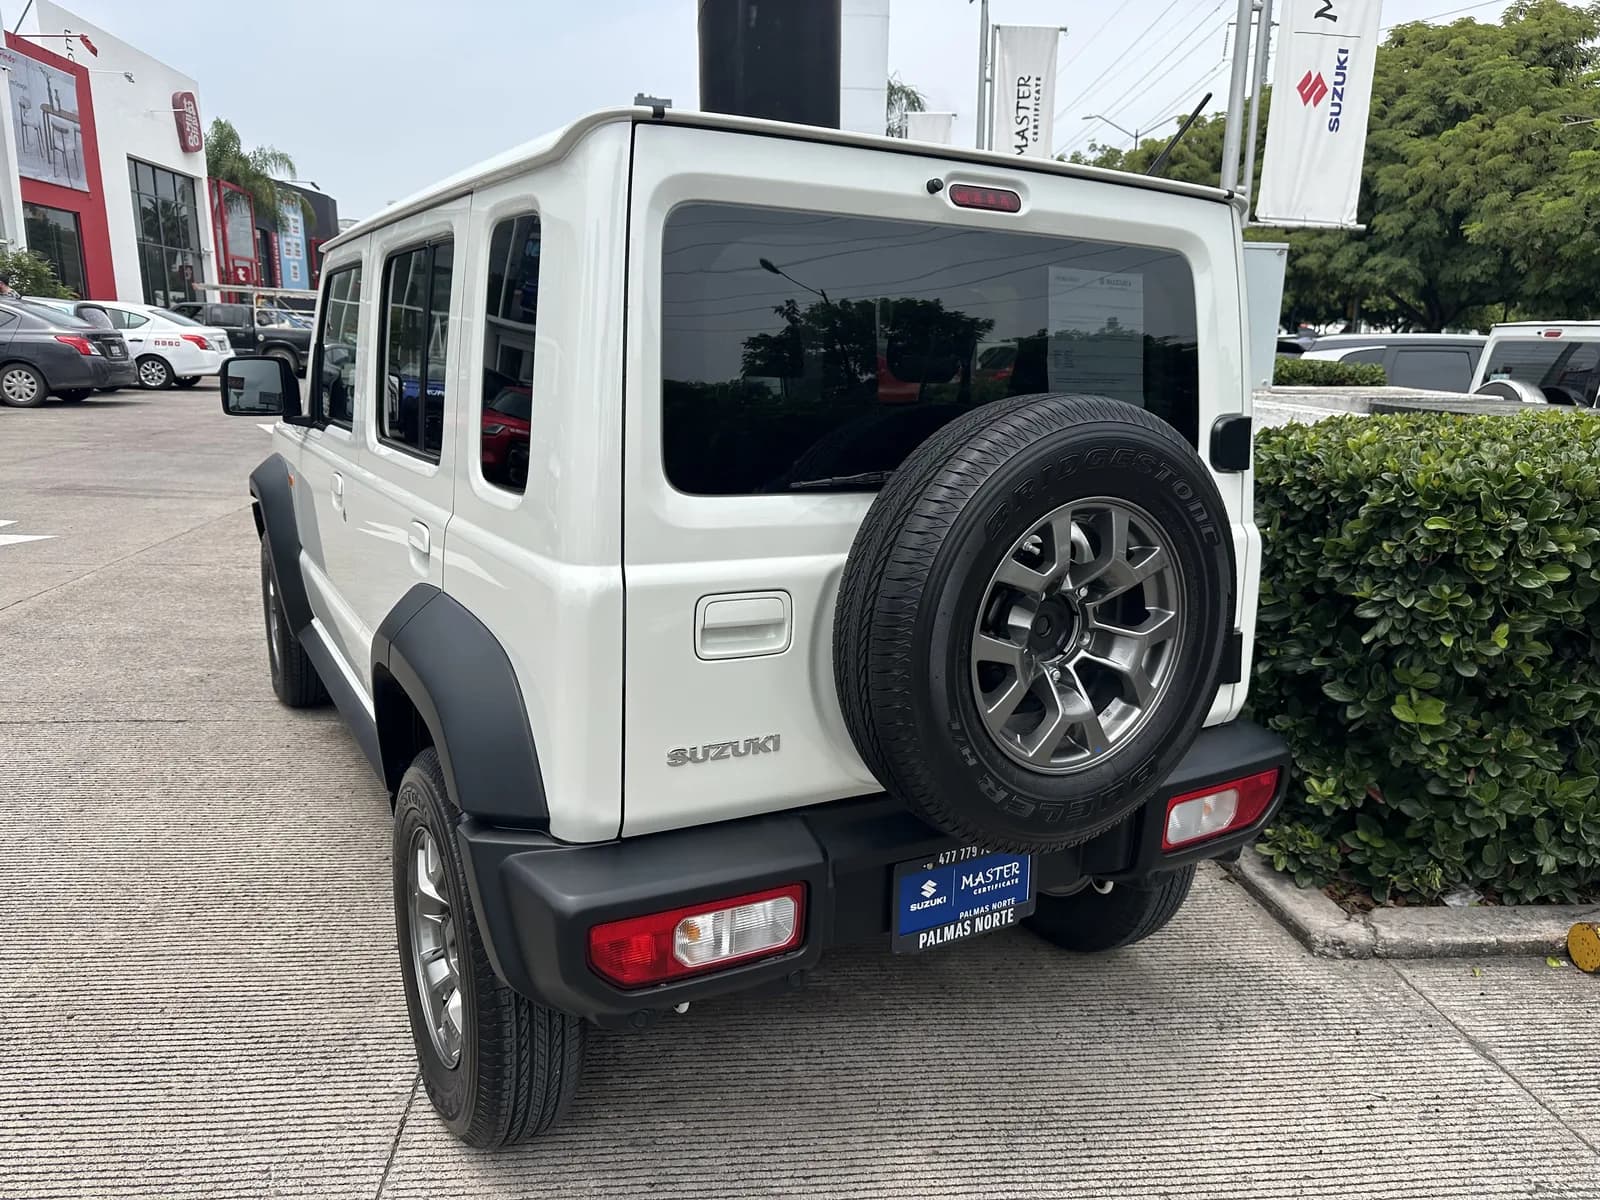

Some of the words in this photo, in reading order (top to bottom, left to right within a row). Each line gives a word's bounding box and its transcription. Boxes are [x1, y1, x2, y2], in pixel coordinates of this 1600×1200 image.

[1328, 48, 1349, 133] SUZUKI
[1032, 77, 1042, 142] CERTIFICATE
[984, 448, 1223, 549] BRIDGESTONE
[667, 733, 781, 767] SUZUKI
[938, 849, 957, 865] 477
[960, 846, 978, 861] 779
[961, 861, 1020, 890] MASTER
[973, 878, 1019, 895] CERTIFICATE
[910, 896, 947, 912] SUZUKI
[959, 904, 990, 920] PALMAS
[991, 897, 1016, 911] NORTE
[918, 920, 972, 950] PALMAS
[974, 907, 1015, 932] NORTE
